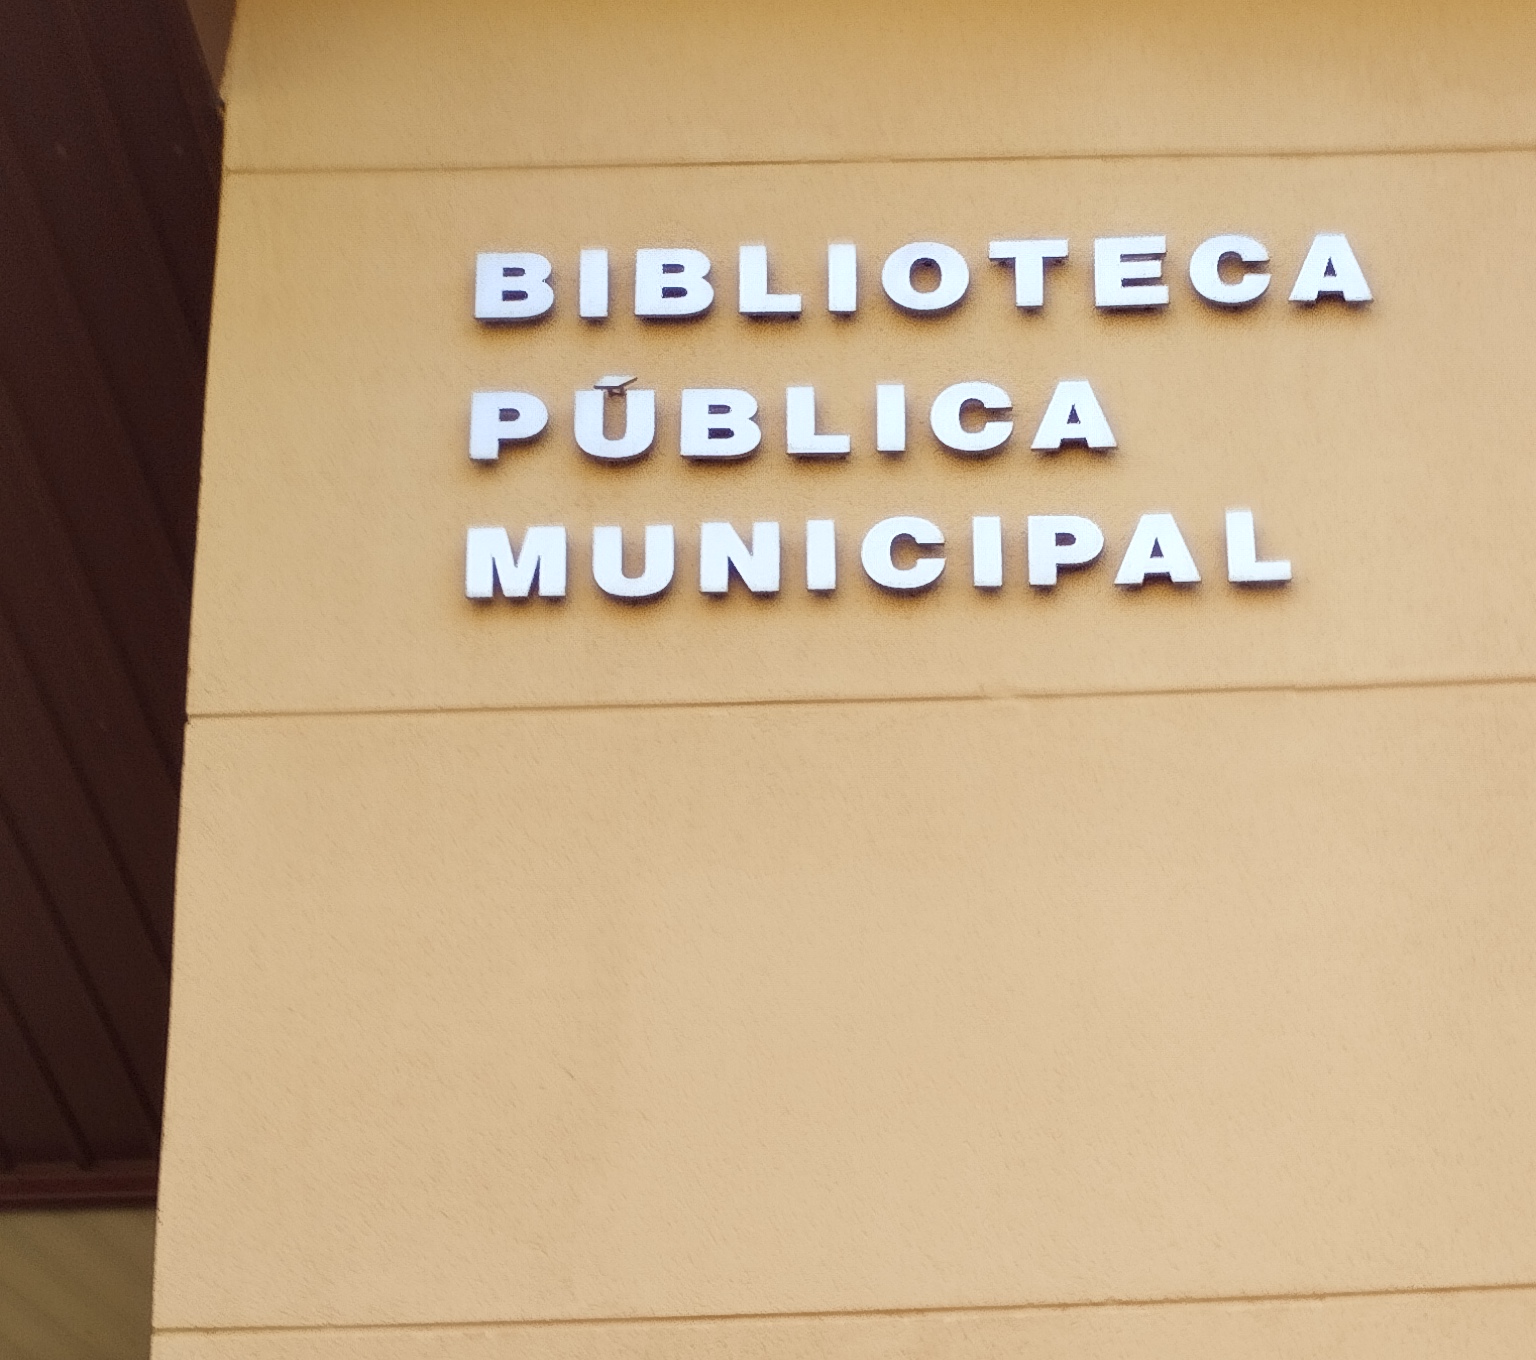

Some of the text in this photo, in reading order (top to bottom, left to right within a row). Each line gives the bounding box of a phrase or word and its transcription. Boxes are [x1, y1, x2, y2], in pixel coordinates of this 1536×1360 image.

[474, 232, 1375, 322] BIBLIOTECA
[468, 375, 1118, 462] PÚBLICA
[464, 508, 1293, 600] MUNICIPAL
